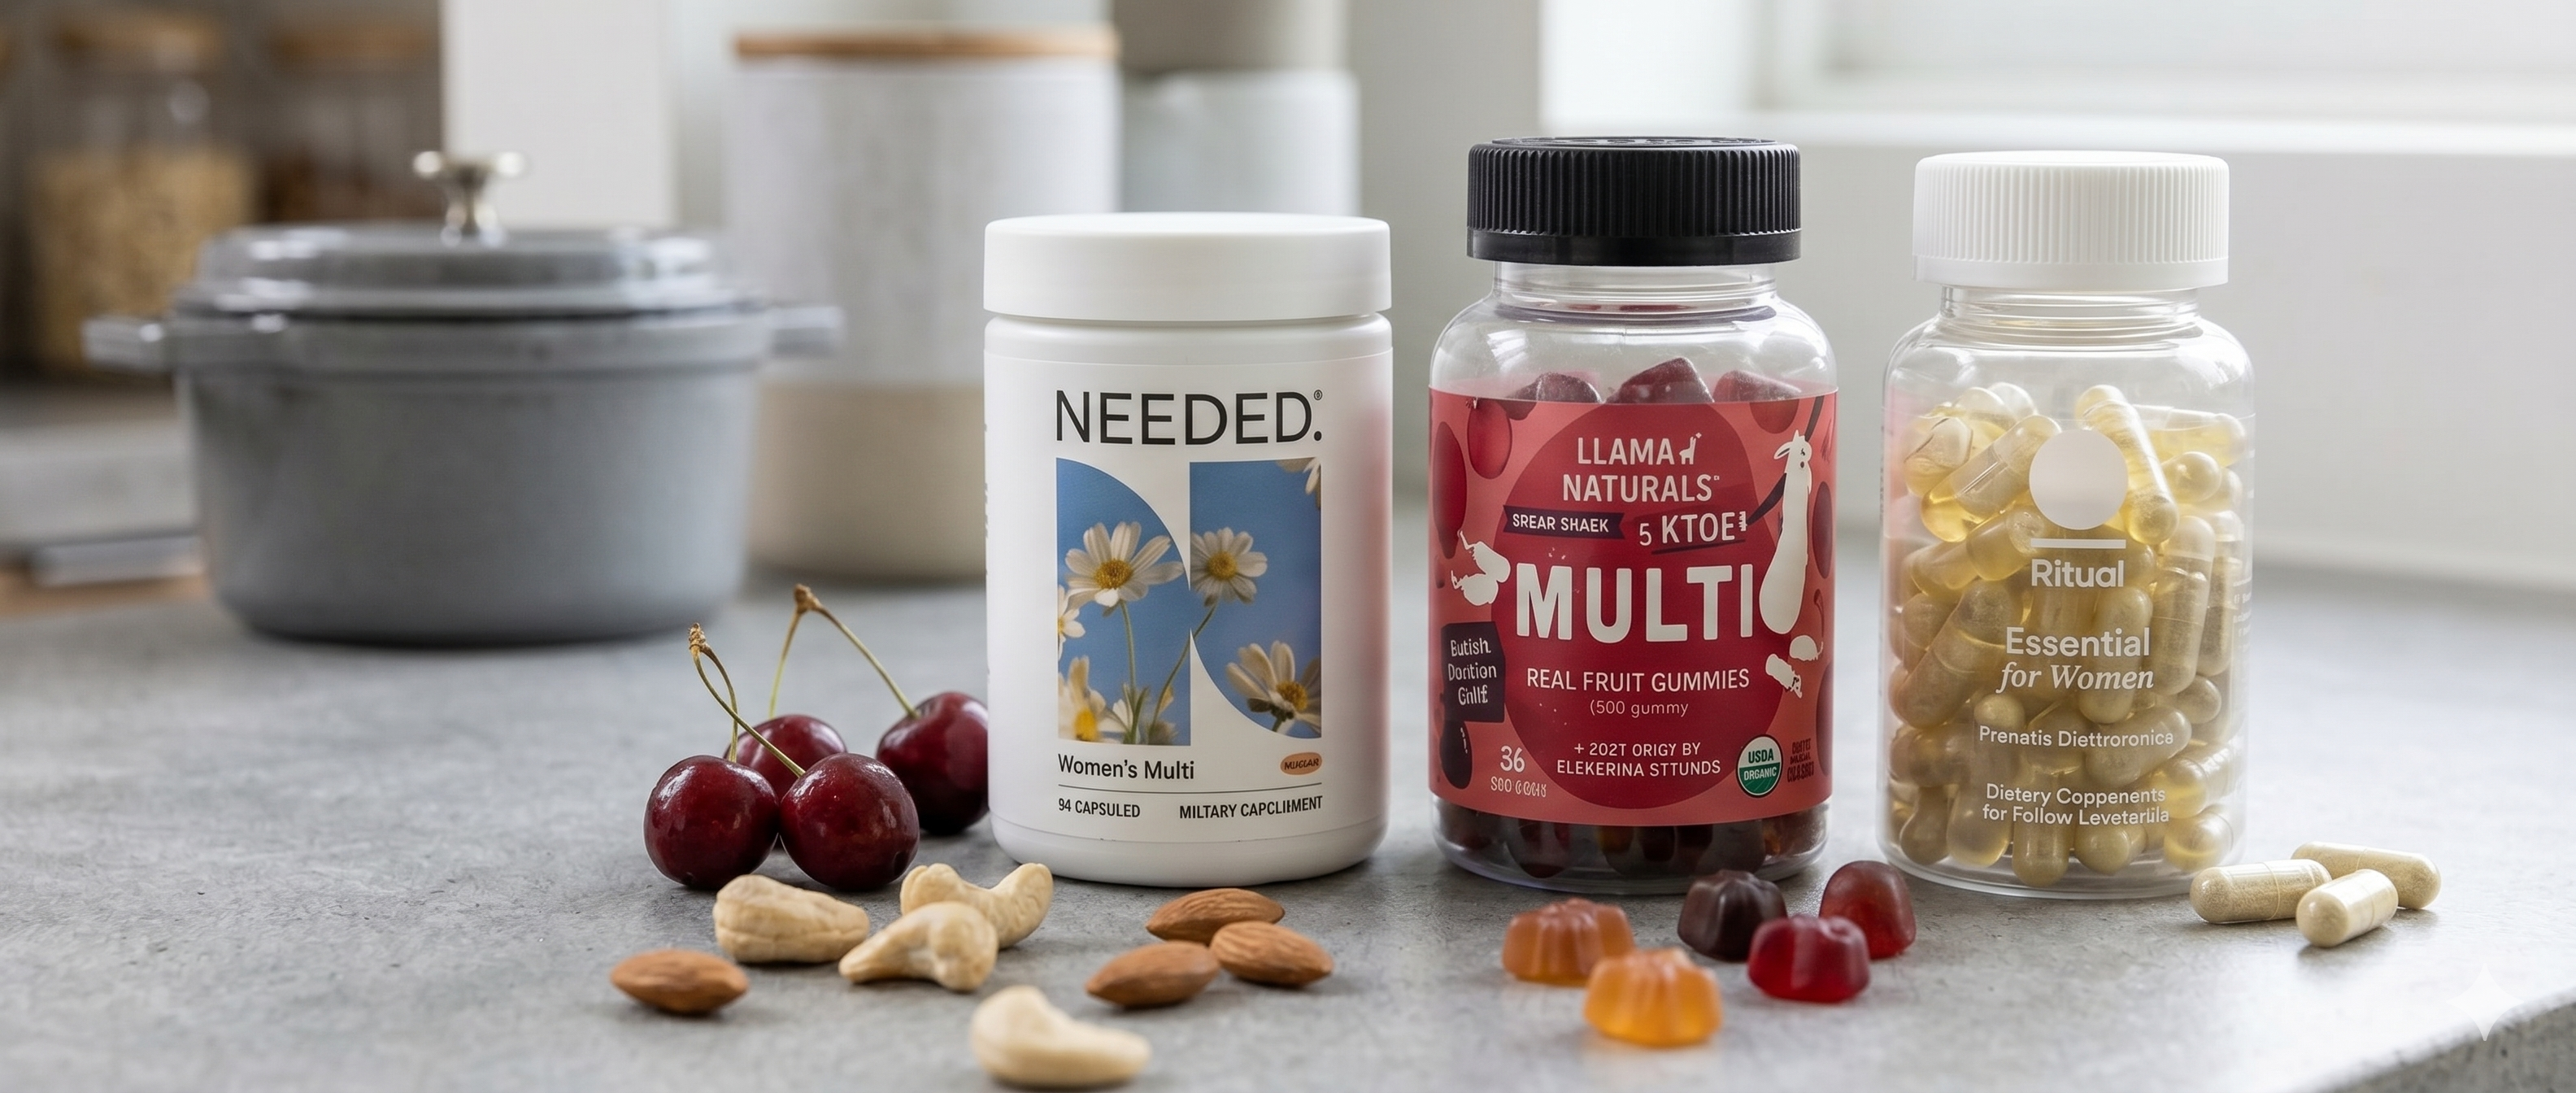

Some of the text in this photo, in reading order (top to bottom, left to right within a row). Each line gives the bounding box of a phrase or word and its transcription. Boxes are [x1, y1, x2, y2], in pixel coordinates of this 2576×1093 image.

[1577, 438, 1675, 465] LLAMA
[1512, 513, 1609, 533] SREAR SHAEK
[1639, 523, 1651, 546] 5
[2032, 559, 2125, 588] Ritual
[1516, 562, 1754, 643] MULTI
[2005, 627, 2151, 657] Essential
[1526, 668, 1751, 692] REAL FRUIT GUMMIES
[1995, 662, 2154, 694] for Women
[1590, 699, 1689, 718] (500 gummy
[1979, 725, 2052, 747] Prenatis
[1499, 745, 1525, 773] 36
[1632, 743, 1677, 757] ORIGY
[1682, 742, 1701, 756] BY
[1748, 748, 1774, 764] USDA
[1144, 761, 1194, 780] Multi
[1557, 760, 1721, 777] ELEKERINA STTUNDS
[1986, 783, 2166, 808] Dietery Coppenents
[1058, 798, 1140, 817] 94 CAPSULED
[1180, 803, 1237, 819] MILTARY
[1982, 804, 2007, 821] for
[2012, 806, 2073, 825] Follow
